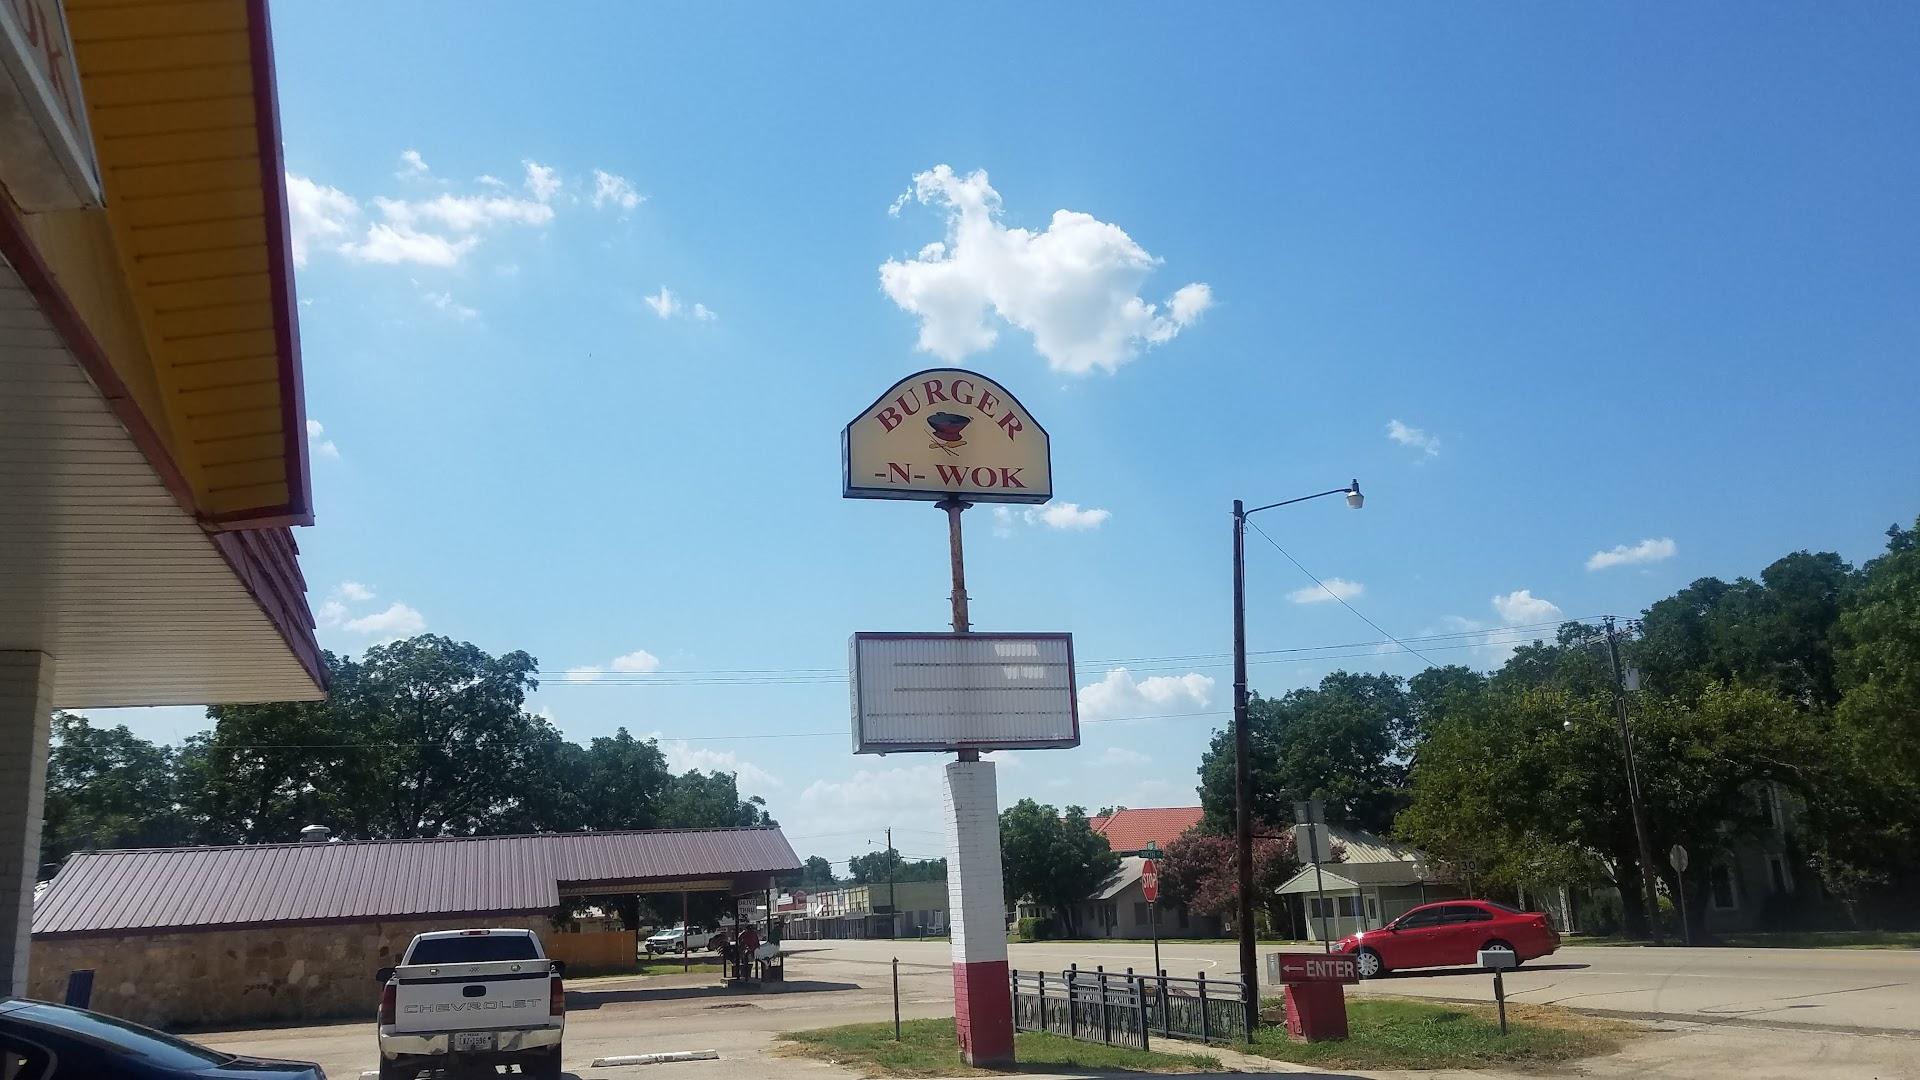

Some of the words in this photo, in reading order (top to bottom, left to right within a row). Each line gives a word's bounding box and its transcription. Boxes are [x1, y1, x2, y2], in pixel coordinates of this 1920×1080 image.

[874, 379, 1023, 441] BURGER
[934, 464, 1028, 488] WOK
[1461, 860, 1476, 870] 30
[1143, 872, 1157, 888] STOP
[1306, 960, 1354, 977] ENTER
[403, 999, 542, 1014] CHEVROLET
